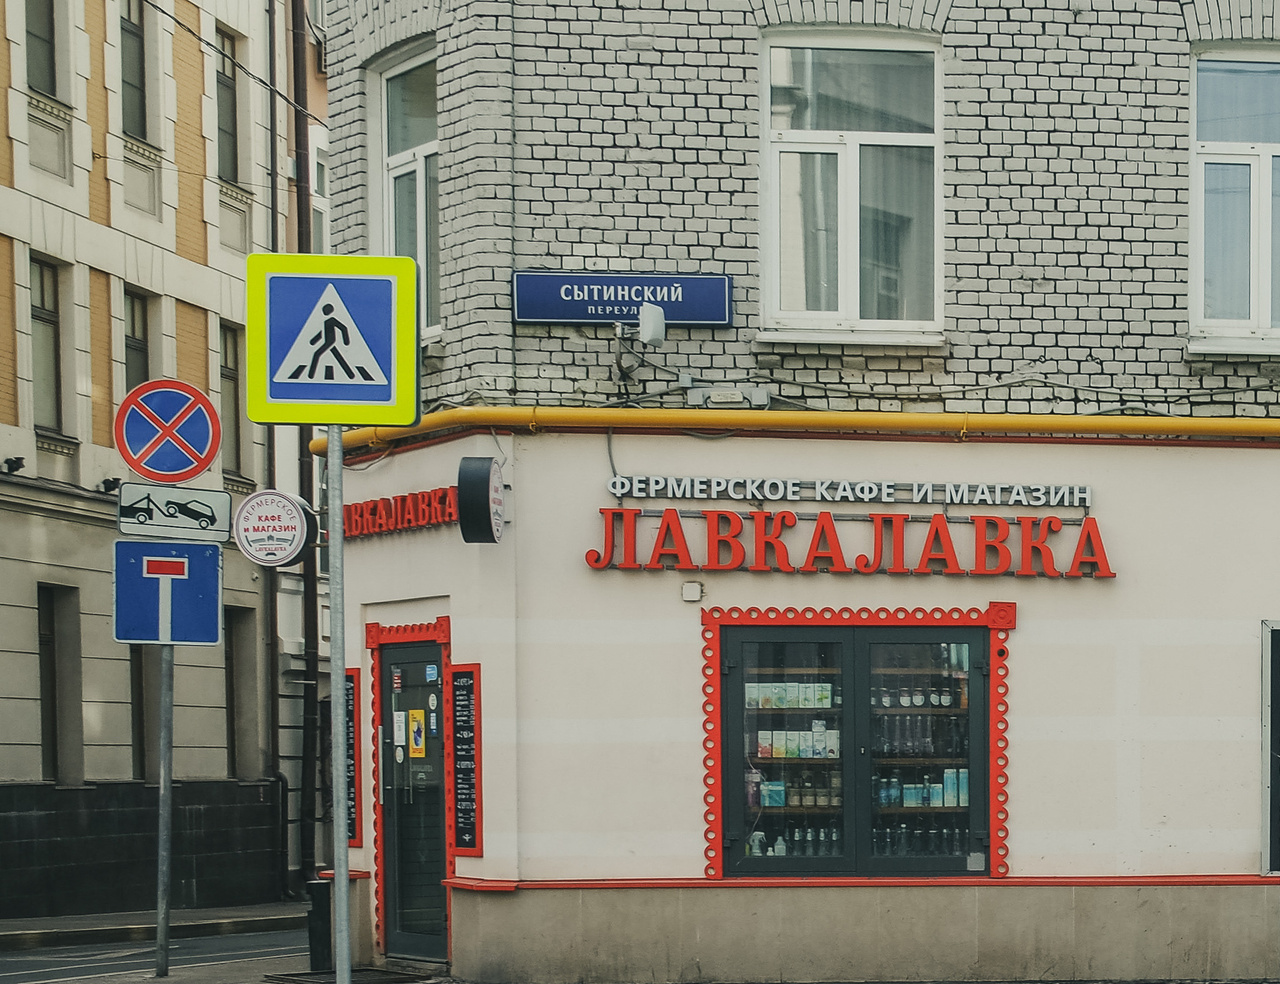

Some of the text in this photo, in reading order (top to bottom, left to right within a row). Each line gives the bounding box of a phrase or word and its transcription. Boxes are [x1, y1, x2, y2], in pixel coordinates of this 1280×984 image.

[560, 283, 683, 302] СЫТИНСКИЙ
[588, 305, 642, 315] ПЕРЕУЛ
[607, 475, 1092, 507] ФЕРМЕРСКОЕ КАФЕ И МАГАЗИН
[243, 498, 297, 523] ФЕРМЕРСКОЕ
[257, 514, 282, 522] КАФЕ
[325, 485, 459, 540] АВКАЛАВКА
[252, 525, 297, 533] МАГАЗИН
[585, 508, 1117, 578] ЛАВКАЛАВКА
